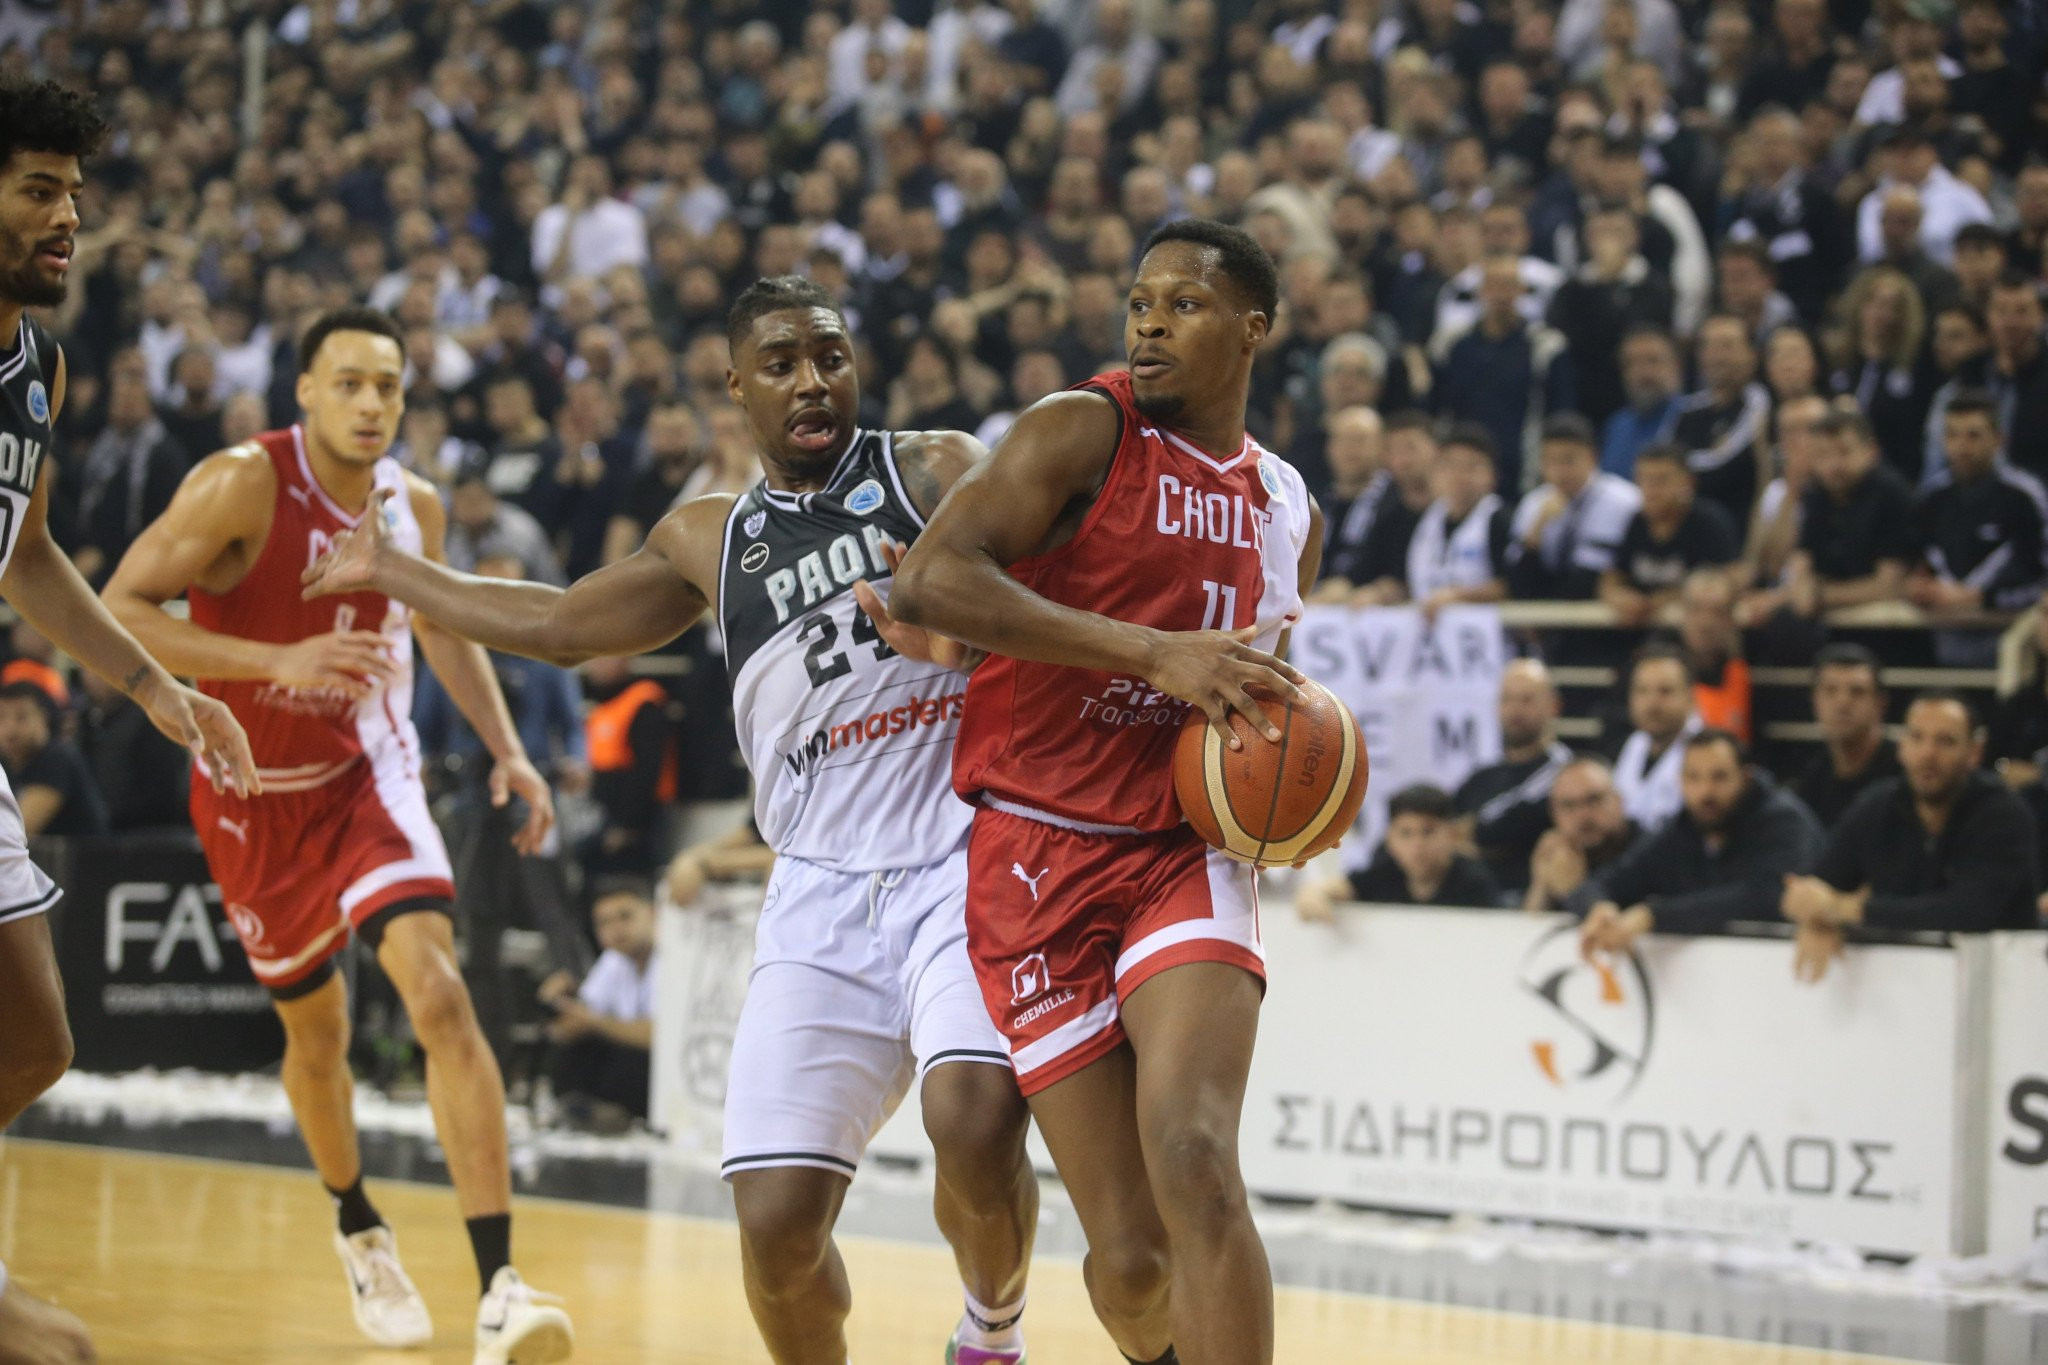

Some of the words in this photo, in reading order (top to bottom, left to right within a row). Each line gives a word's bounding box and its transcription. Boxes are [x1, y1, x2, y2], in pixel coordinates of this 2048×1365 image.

[1157, 474, 1272, 551] CHOLT
[796, 600, 900, 689] 24
[1287, 623, 1493, 683] SVAR
[786, 691, 966, 777] winmasters
[1272, 1094, 1896, 1205] ΣΙΔΗΡΟΠΟΥΛΟΣ
